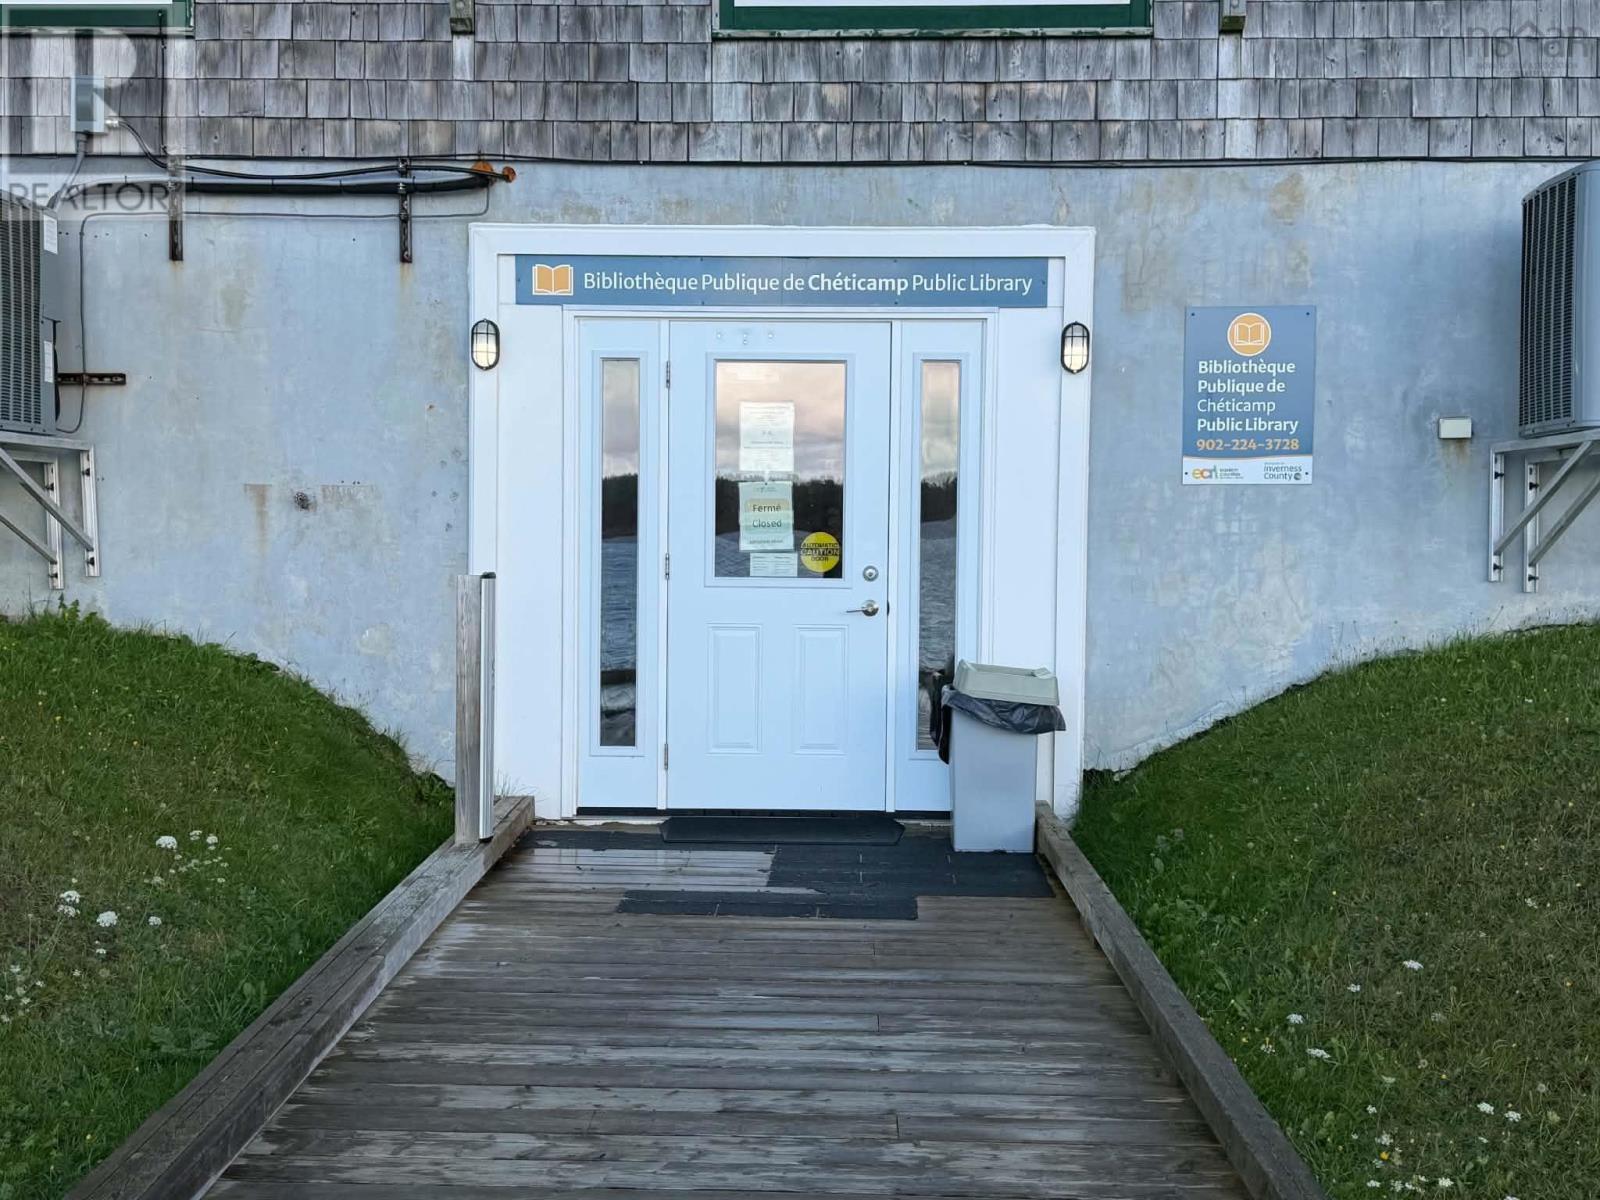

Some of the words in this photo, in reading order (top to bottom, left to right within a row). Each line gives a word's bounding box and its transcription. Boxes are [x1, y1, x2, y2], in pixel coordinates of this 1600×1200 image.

[584, 272, 698, 295] Bibliothèque
[702, 273, 780, 295] Publique
[783, 273, 804, 291] de
[808, 272, 909, 295] Chéticamp
[912, 273, 967, 291] Public
[970, 273, 1033, 296] Library
[1198, 359, 1296, 376] Bibliothèque
[1198, 379, 1264, 396] Publique
[1266, 379, 1286, 393] de
[1197, 398, 1276, 415] Chéticamp
[1197, 417, 1243, 432] Public
[1245, 417, 1299, 435] Library
[1196, 438, 1300, 451] 902-224-3728
[752, 504, 782, 513] Fermé
[752, 519, 782, 529] Closed
[801, 548, 840, 556] CAUTION
